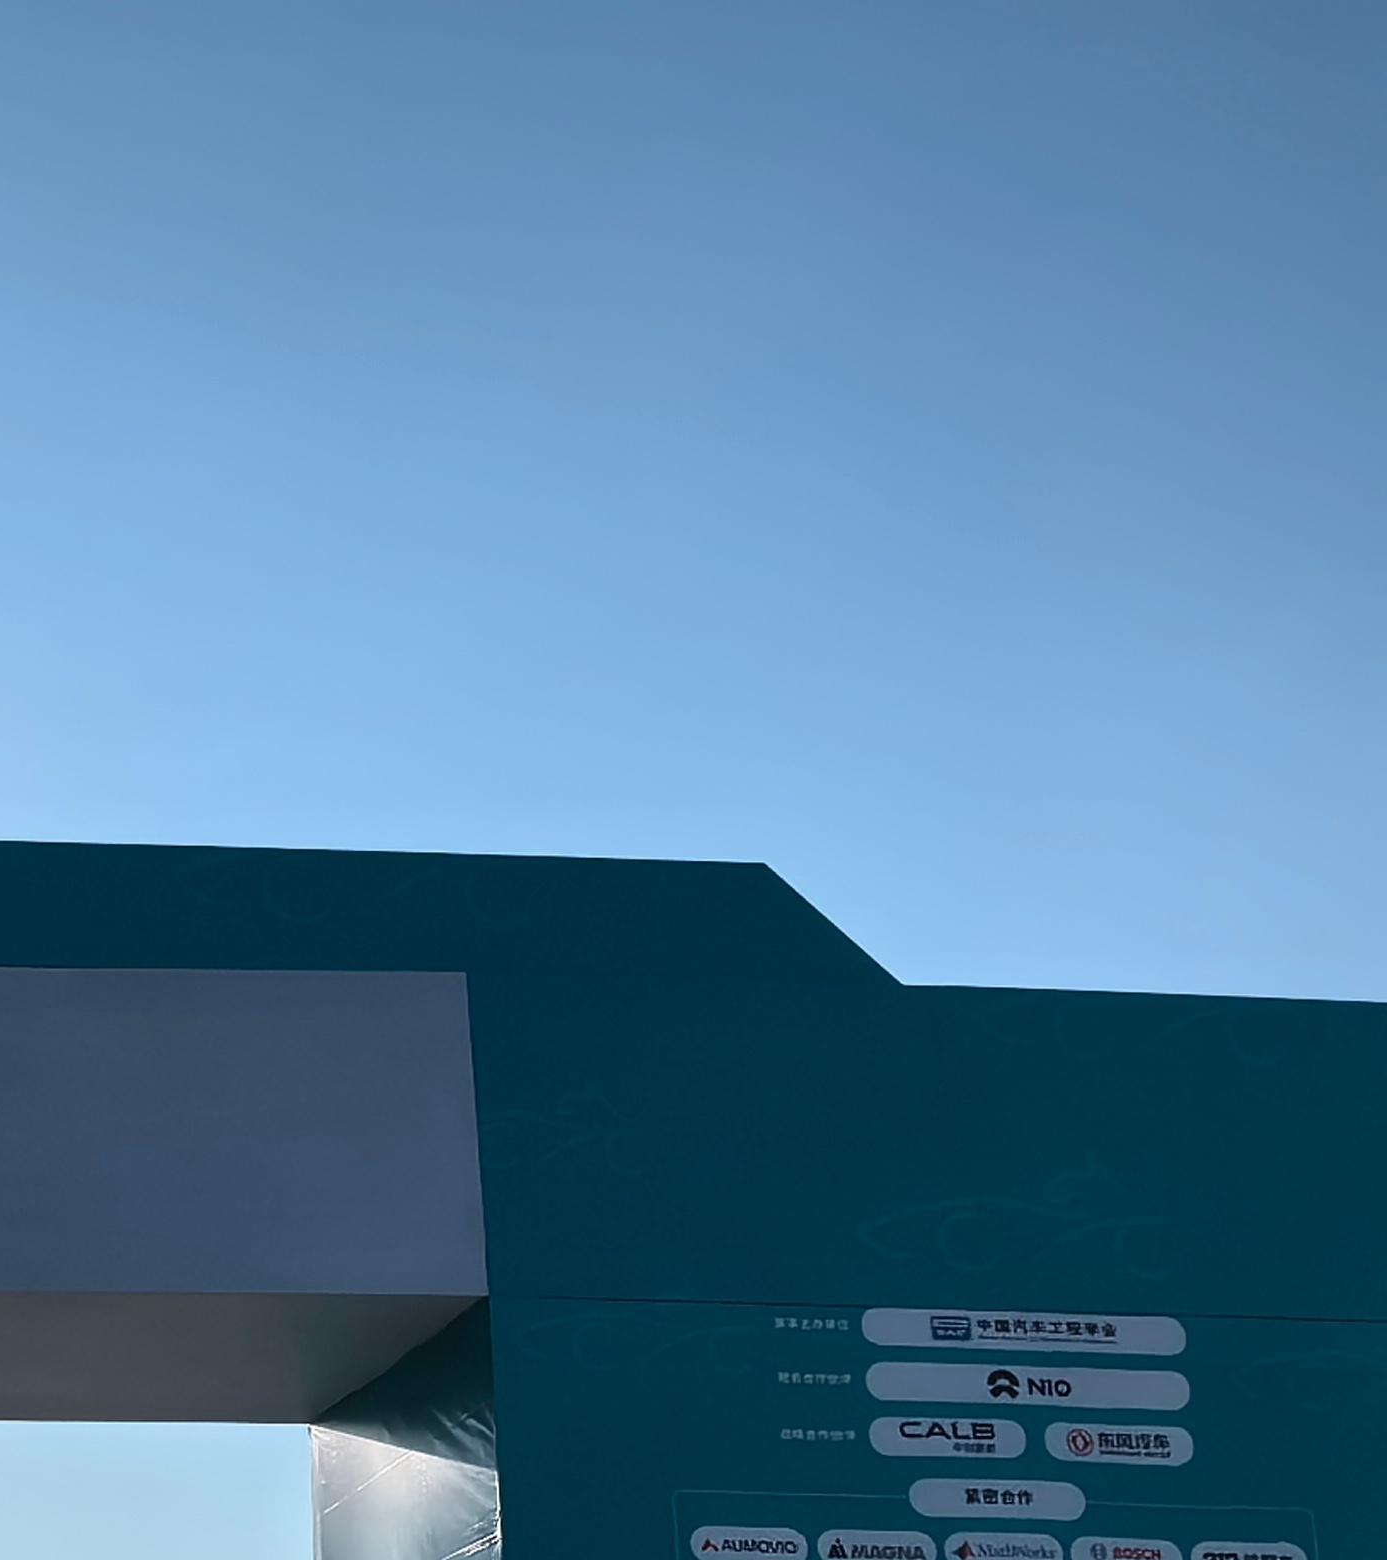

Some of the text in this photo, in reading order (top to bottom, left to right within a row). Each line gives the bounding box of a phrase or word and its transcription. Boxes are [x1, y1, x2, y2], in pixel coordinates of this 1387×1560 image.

[977, 1319, 1117, 1337] 中国汽车工程学会
[1027, 1378, 1072, 1397] NIO
[899, 1420, 996, 1441] CALB
[1096, 1432, 1170, 1450] 东风汽车
[964, 1487, 1034, 1507] 紧密合作
[850, 1545, 927, 1560] MAGNA
[1113, 1546, 1162, 1560] BOSCH
